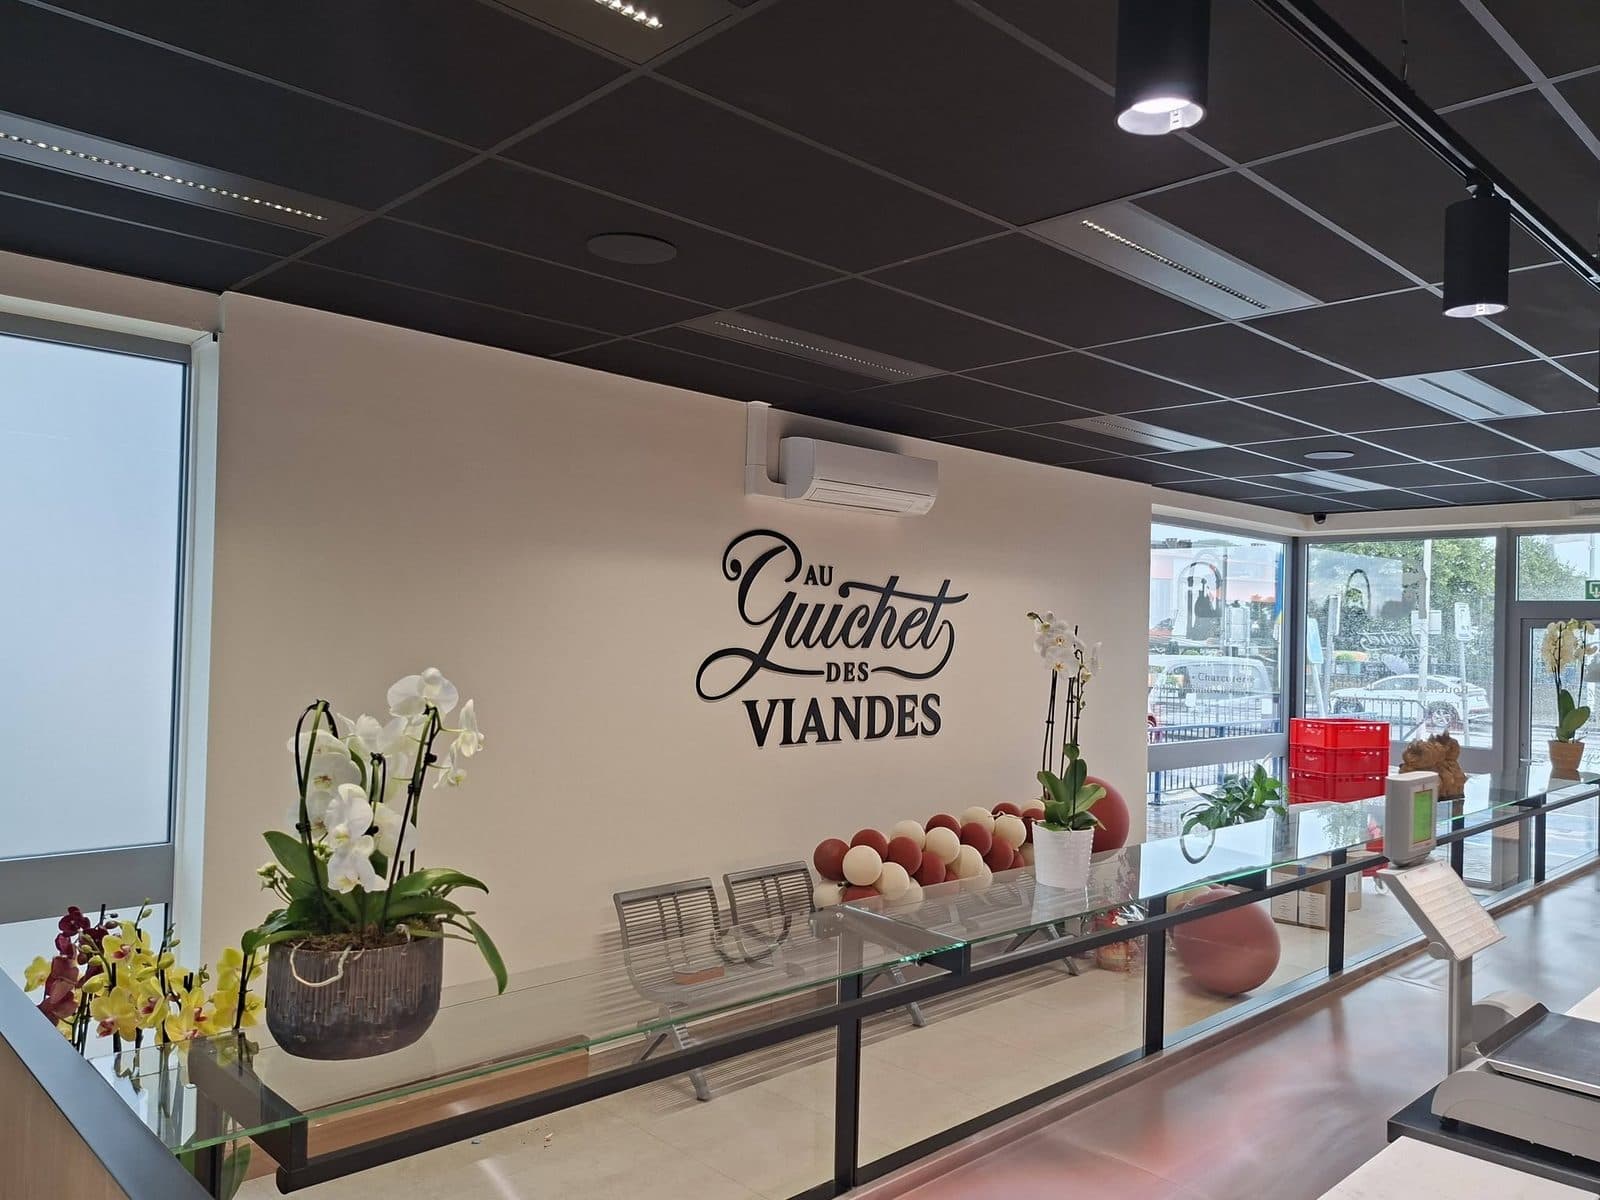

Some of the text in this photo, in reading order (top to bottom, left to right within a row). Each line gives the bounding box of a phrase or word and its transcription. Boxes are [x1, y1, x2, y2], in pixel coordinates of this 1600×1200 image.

[803, 565, 834, 586] AU
[696, 529, 969, 700] Guichet
[825, 661, 869, 682] DES
[742, 693, 942, 748] VIANDES
